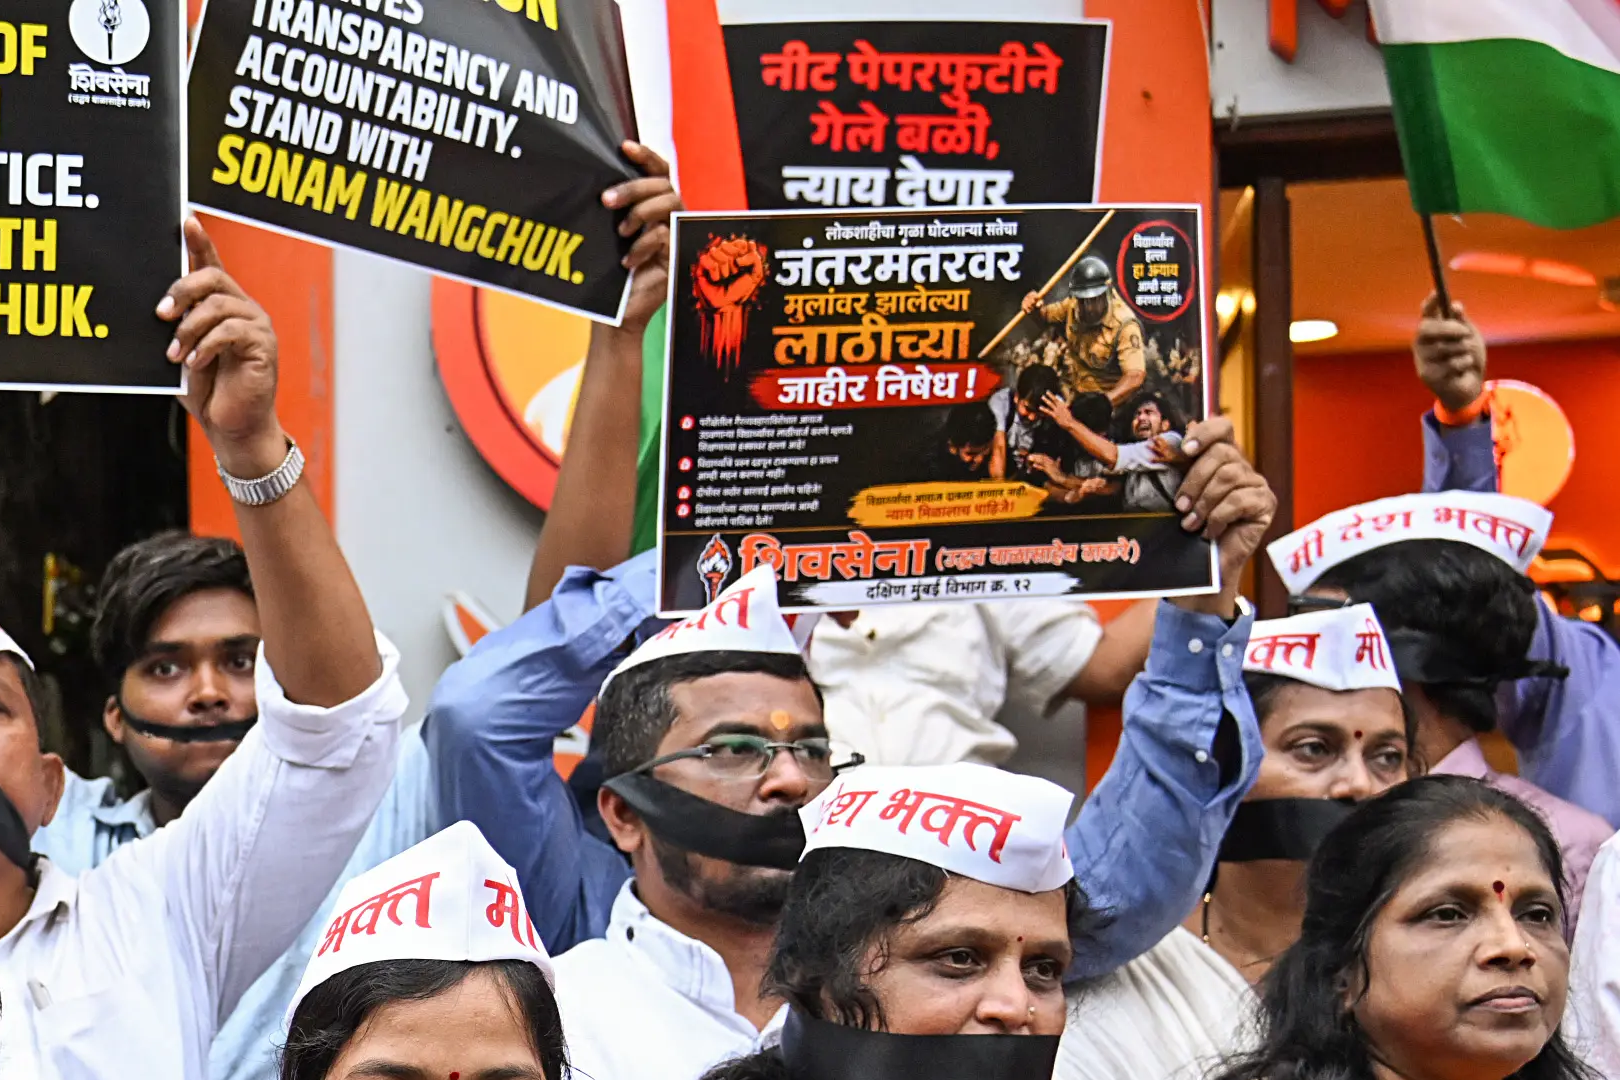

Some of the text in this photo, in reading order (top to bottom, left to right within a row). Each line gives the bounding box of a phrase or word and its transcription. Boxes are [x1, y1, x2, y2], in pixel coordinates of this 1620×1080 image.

[68, 63, 151, 96] शिवसेना
[253, 0, 578, 124] TRANSPARENCY AND
[760, 39, 1063, 109] नीट पेपरफुटीने
[236, 35, 521, 158] ACCOUNTABILITY.
[225, 86, 432, 181] STAND WITH
[810, 100, 1000, 160] गेले बळी,
[782, 155, 1014, 208] न्याय देणार
[212, 134, 583, 284] SONAM WANGCHUK.
[825, 220, 896, 241] लोकशाहीचा
[775, 237, 1023, 287] जंतरमंतरवर
[784, 284, 971, 324] मुलांवर झालेल्या
[772, 312, 975, 365] लाठीच्या
[778, 367, 869, 407] जाहीर
[876, 365, 959, 401] निषेध
[738, 530, 931, 583] शिवसेना
[1286, 506, 1534, 573] मी देश भक्त
[865, 580, 908, 600] दक्षिण
[911, 578, 941, 601] मुंबई
[945, 576, 986, 596] विभाग
[1355, 617, 1388, 670] मी
[878, 788, 1022, 864] भक्त
[317, 871, 440, 957] भक्त
